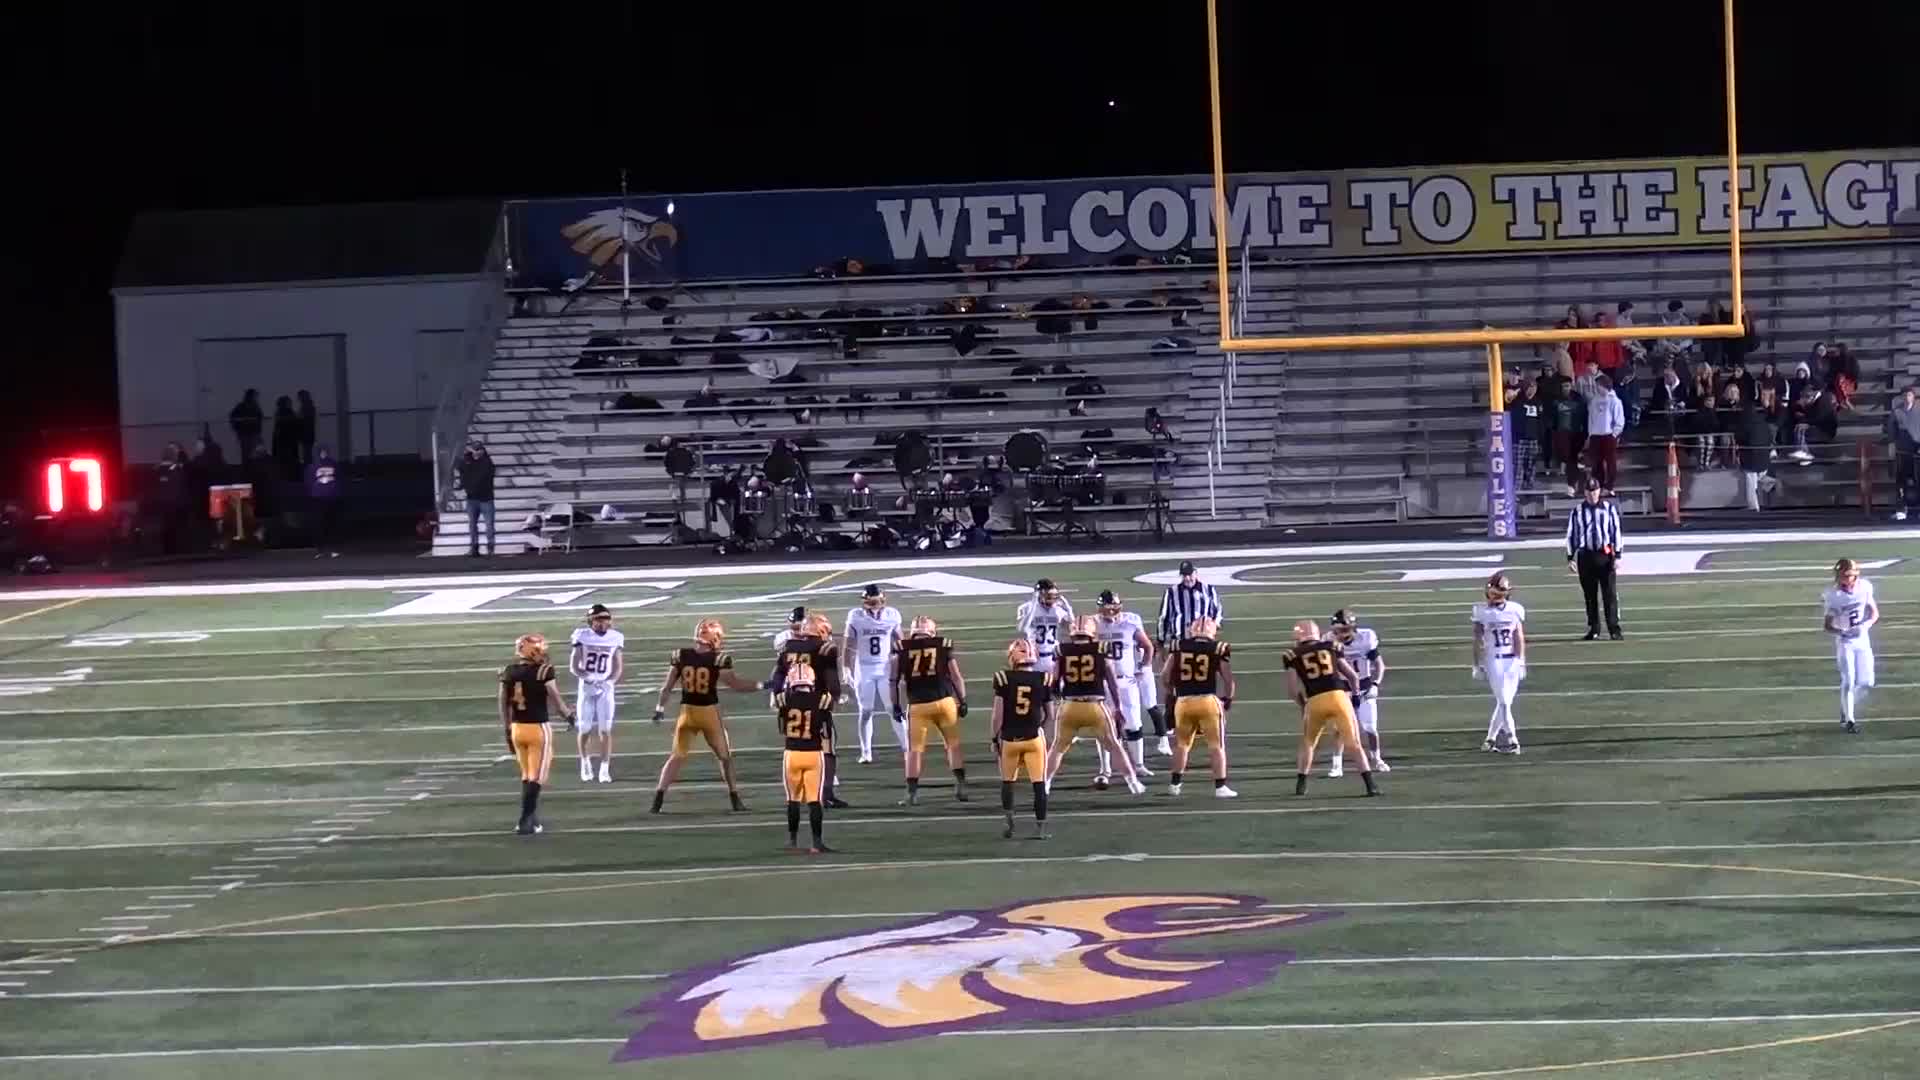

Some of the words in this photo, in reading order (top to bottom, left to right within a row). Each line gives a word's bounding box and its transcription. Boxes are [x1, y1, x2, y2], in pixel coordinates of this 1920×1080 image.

[876, 184, 1331, 260] WELCOME
[1348, 175, 1476, 245] TO
[1492, 167, 1679, 240] THE
[47, 458, 103, 513] 17
[1489, 414, 1507, 537] EAGLES
[869, 636, 881, 655] 8
[585, 651, 607, 673] 20
[908, 648, 937, 677] 77
[1064, 654, 1096, 683] 52
[1179, 652, 1209, 682] 53
[1302, 651, 1334, 679] 59
[681, 666, 710, 695] 88
[512, 684, 528, 711] 4
[1015, 685, 1032, 716] 5
[786, 710, 812, 740] 21
